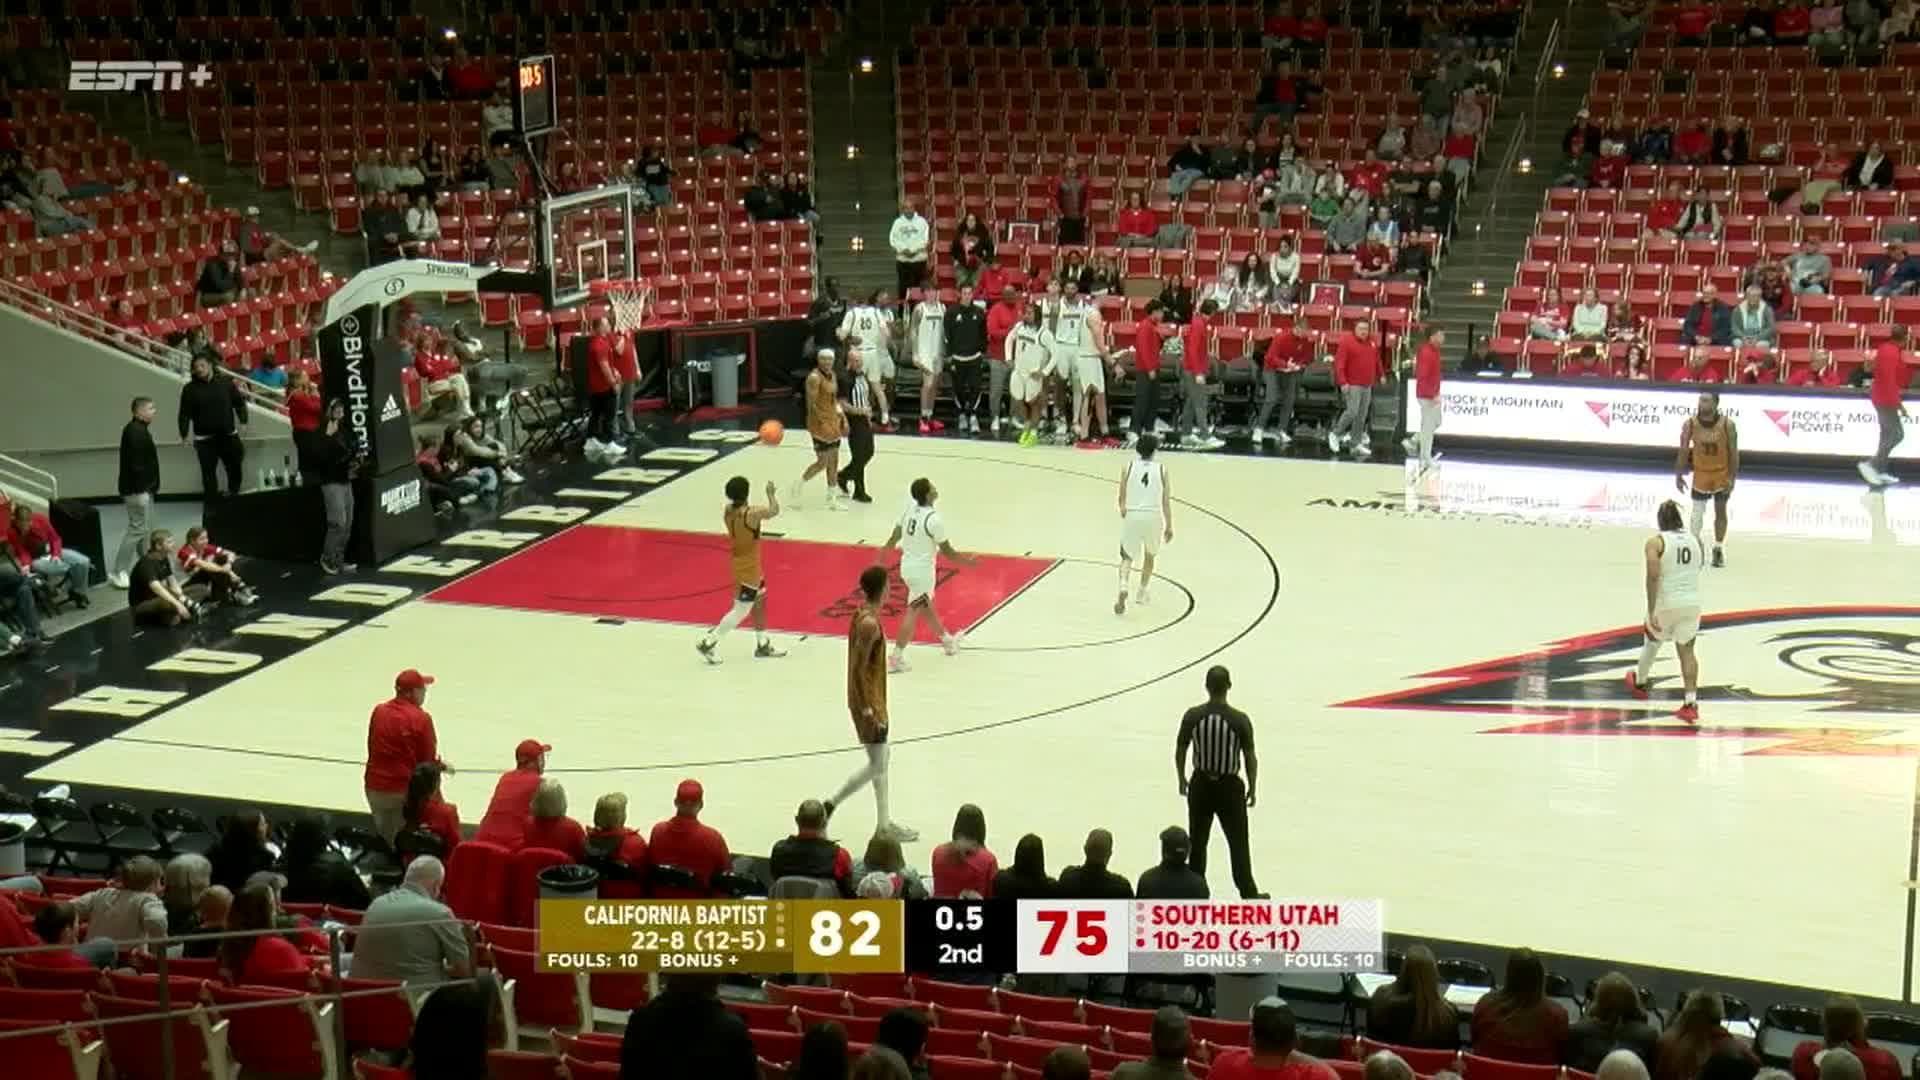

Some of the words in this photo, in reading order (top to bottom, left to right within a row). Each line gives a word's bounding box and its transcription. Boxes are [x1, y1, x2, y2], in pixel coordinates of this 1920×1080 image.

[343, 336, 369, 458] BlvdHom
[1492, 396, 1563, 409] MOUNTAIN
[1443, 404, 1489, 416] POWER
[1612, 402, 1659, 415] ROCKY
[1612, 413, 1661, 424] POWER
[1792, 410, 1842, 421] ROCKY
[1792, 421, 1844, 432] POWER
[1141, 472, 1149, 488] 4
[1676, 547, 1691, 564] 10
